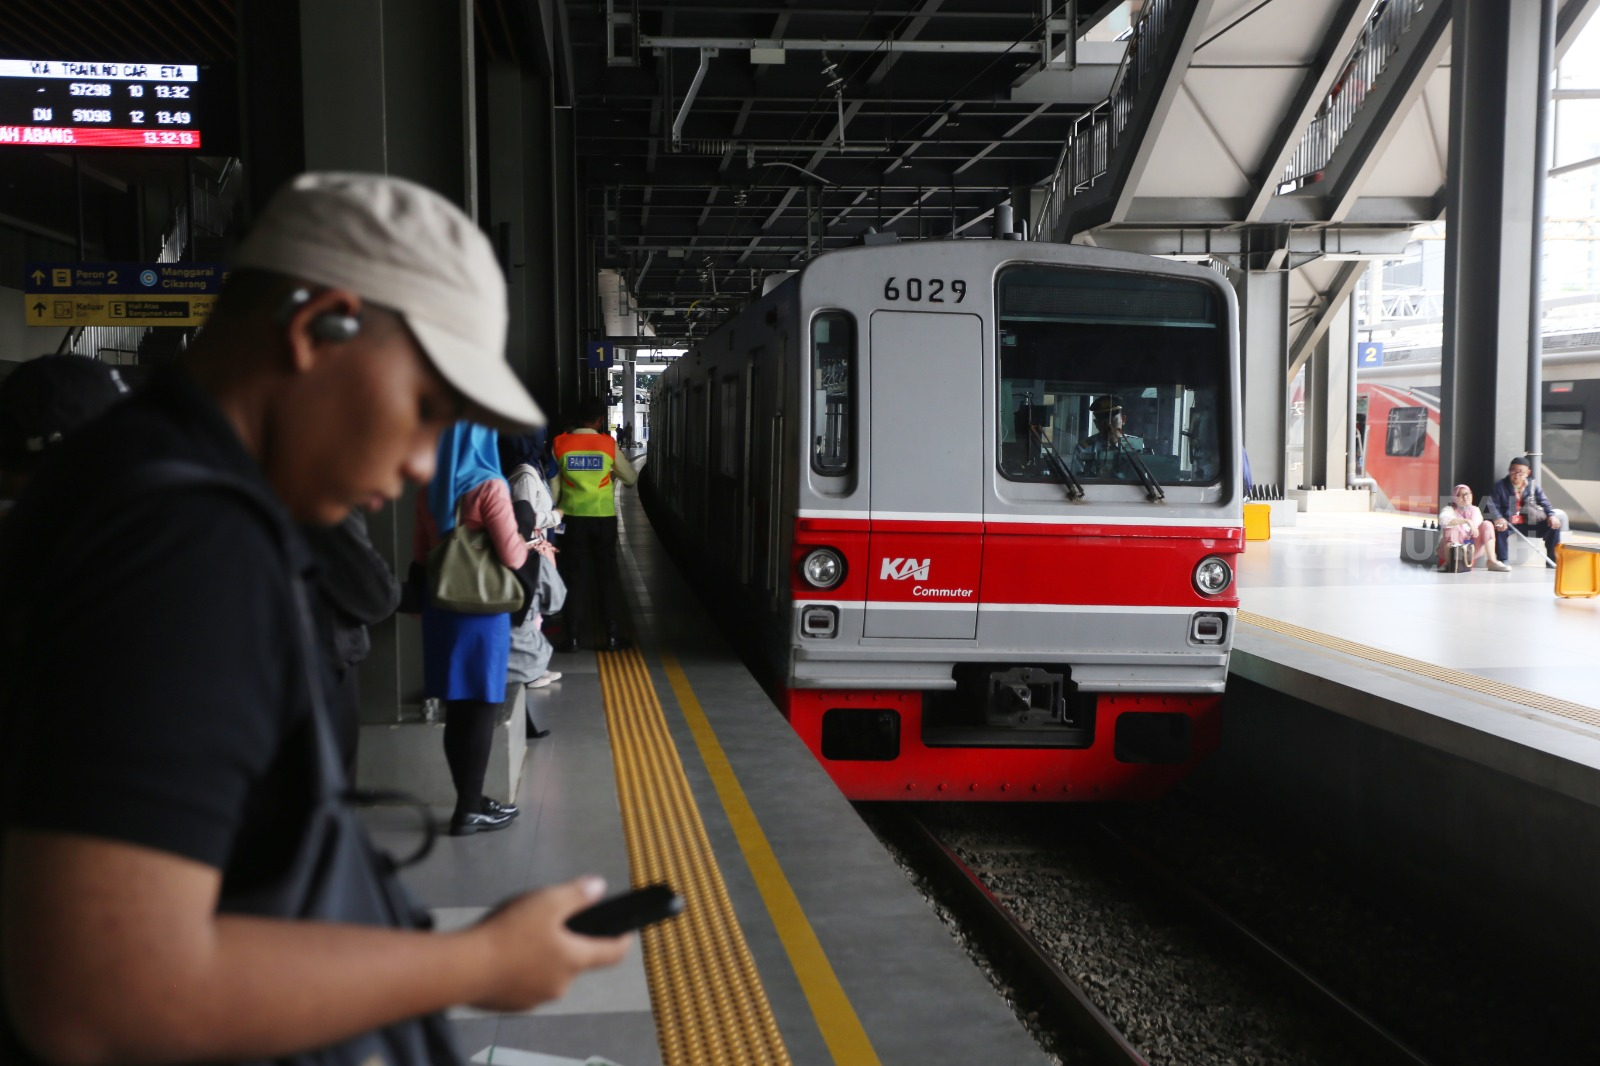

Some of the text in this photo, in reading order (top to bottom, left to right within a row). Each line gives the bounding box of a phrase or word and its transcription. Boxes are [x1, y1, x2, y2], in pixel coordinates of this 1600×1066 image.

[30, 62, 51, 74] VIA
[123, 65, 148, 77] CAR
[160, 66, 183, 78] ETA
[128, 84, 144, 97] 10
[155, 85, 190, 98] 13:32
[33, 107, 52, 121] DU
[129, 110, 145, 123] 12
[156, 111, 191, 124] 13:49
[143, 131, 193, 145] 13:32:13
[76, 270, 104, 279] Peron
[107, 270, 118, 285] 2
[162, 267, 214, 278] Manggarai
[162, 279, 206, 290] Cikarang
[884, 277, 967, 303] 6029
[76, 303, 104, 311] Keluar
[114, 304, 122, 315] E
[596, 347, 604, 361] 1
[1365, 347, 1376, 361] 2
[570, 457, 585, 467] PAM
[880, 557, 931, 581] KAI
[912, 585, 973, 597] Commuter
